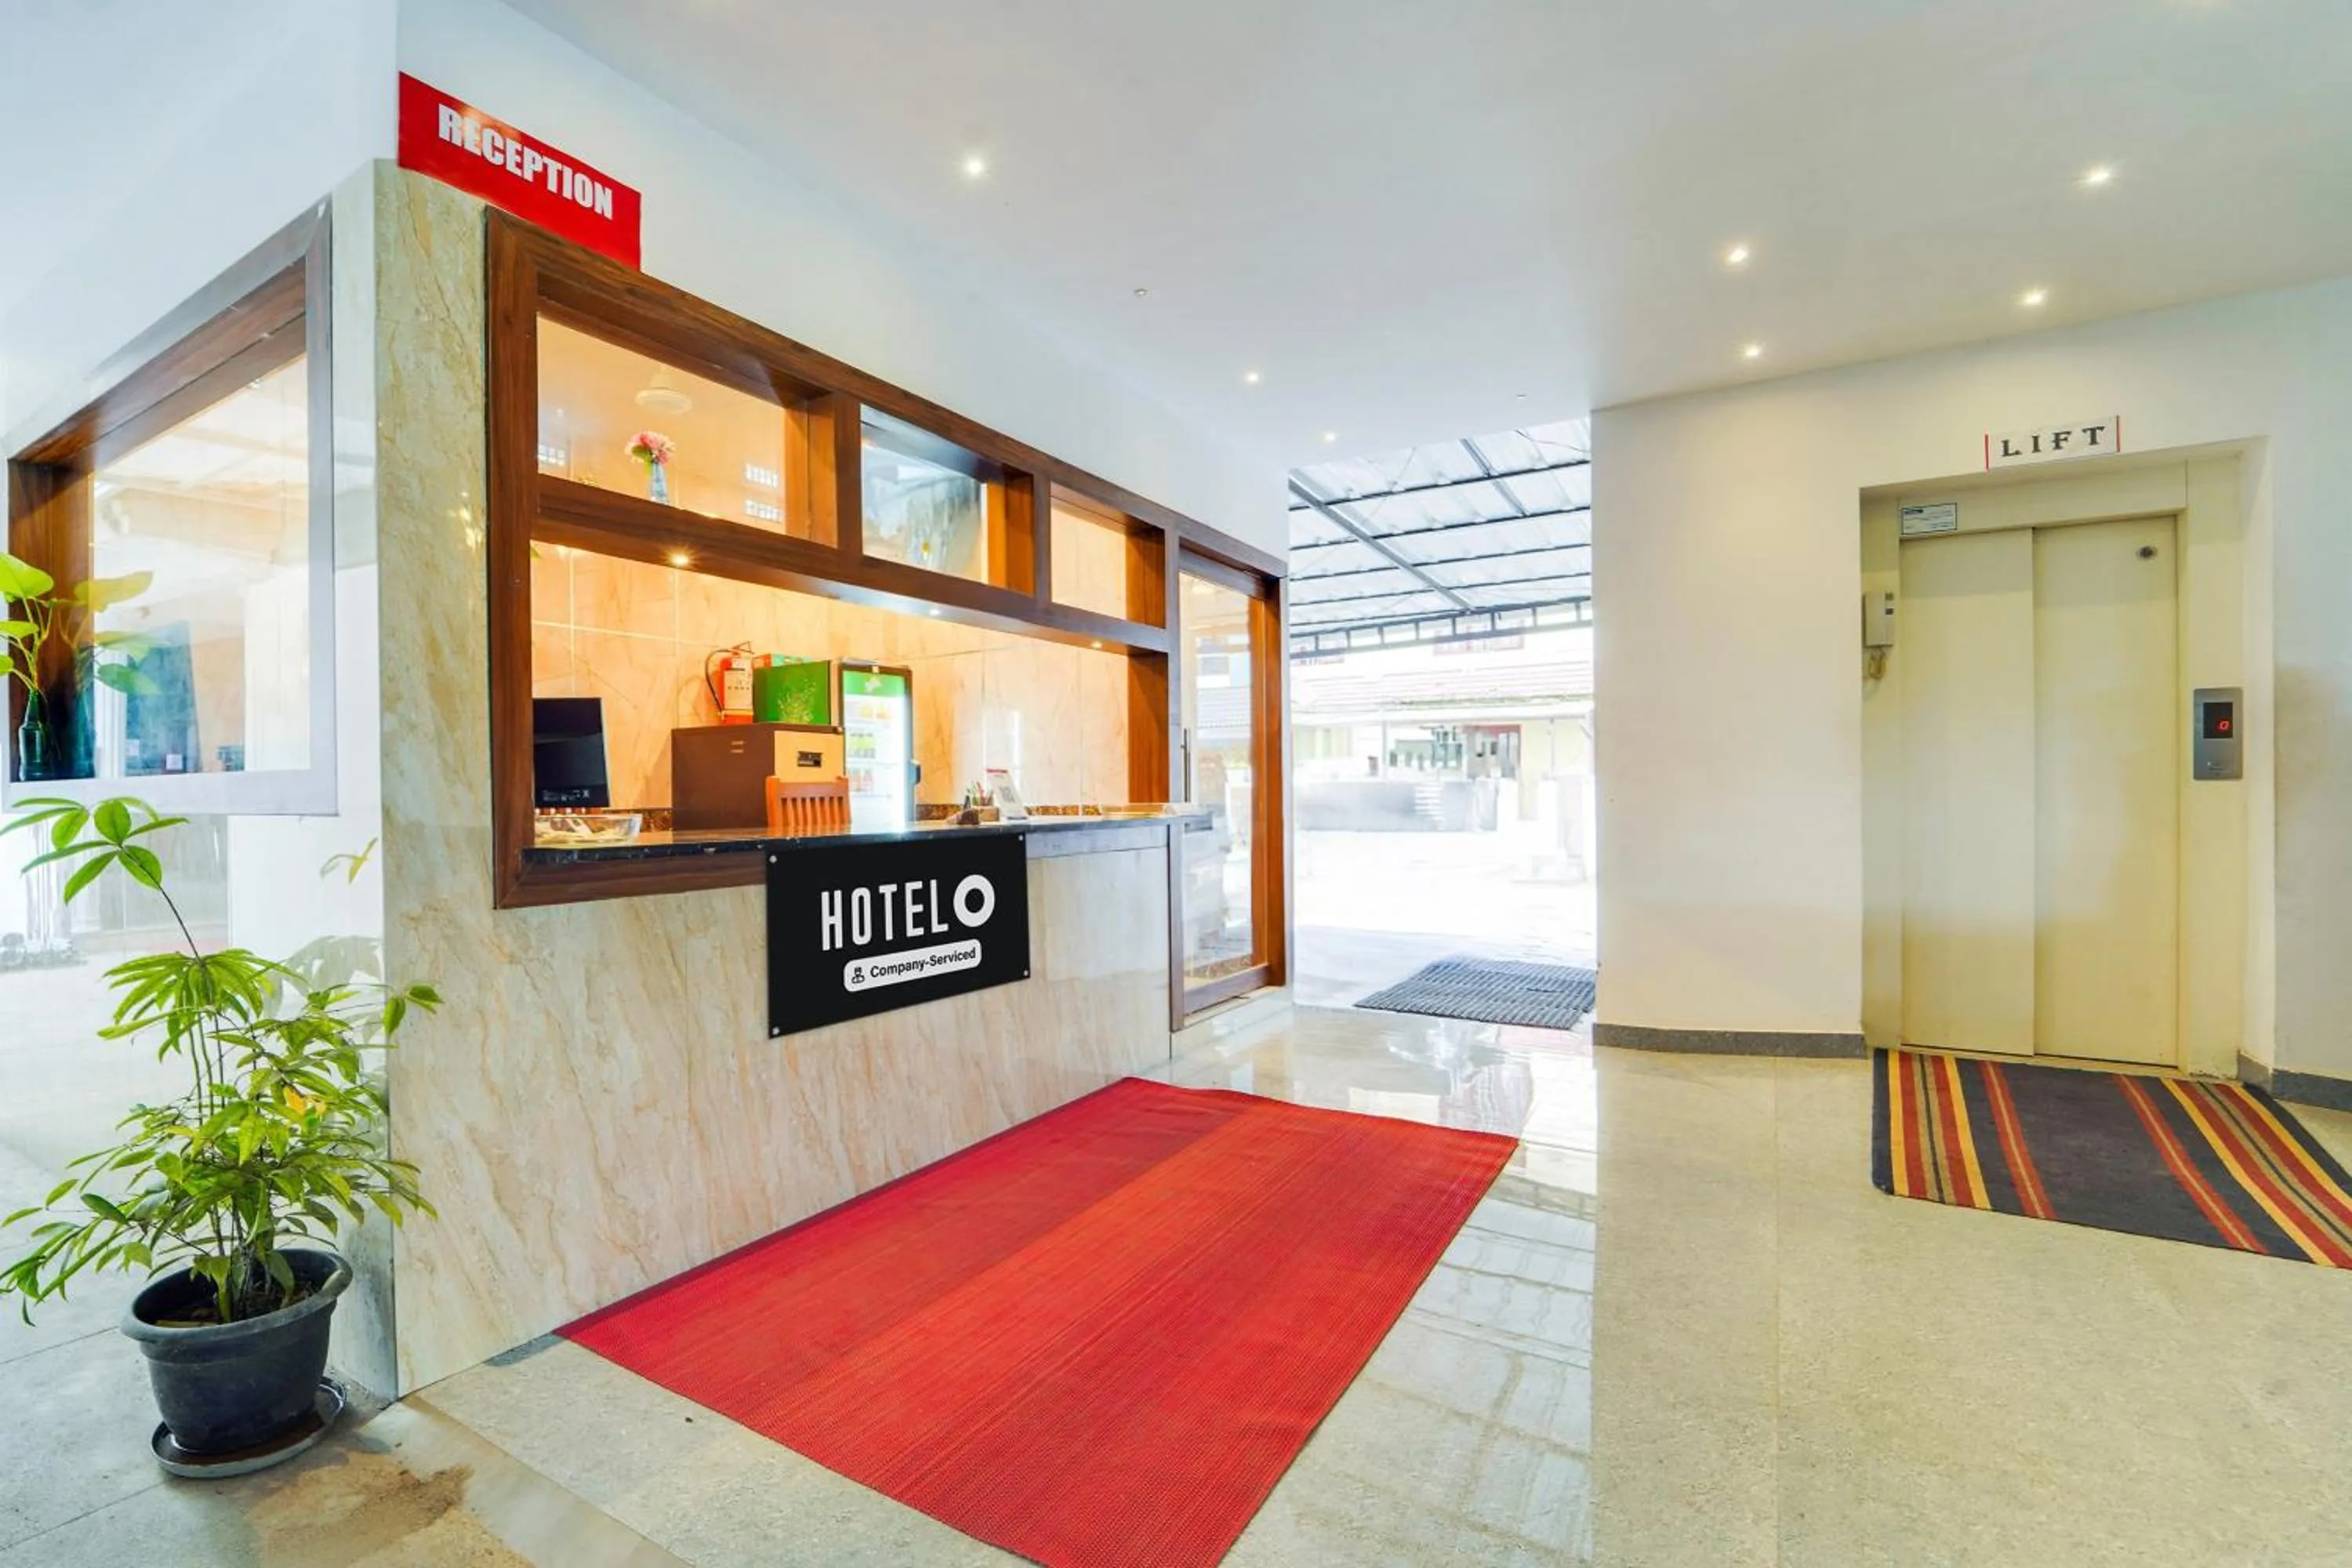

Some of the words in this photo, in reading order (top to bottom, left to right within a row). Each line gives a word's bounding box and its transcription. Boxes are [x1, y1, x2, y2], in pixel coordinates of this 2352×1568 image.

[438, 103, 612, 220] RECEPTION
[2001, 426, 2105, 457] LIFT
[821, 879, 949, 951] HOTEL
[869, 947, 976, 978] Company-Serviced
